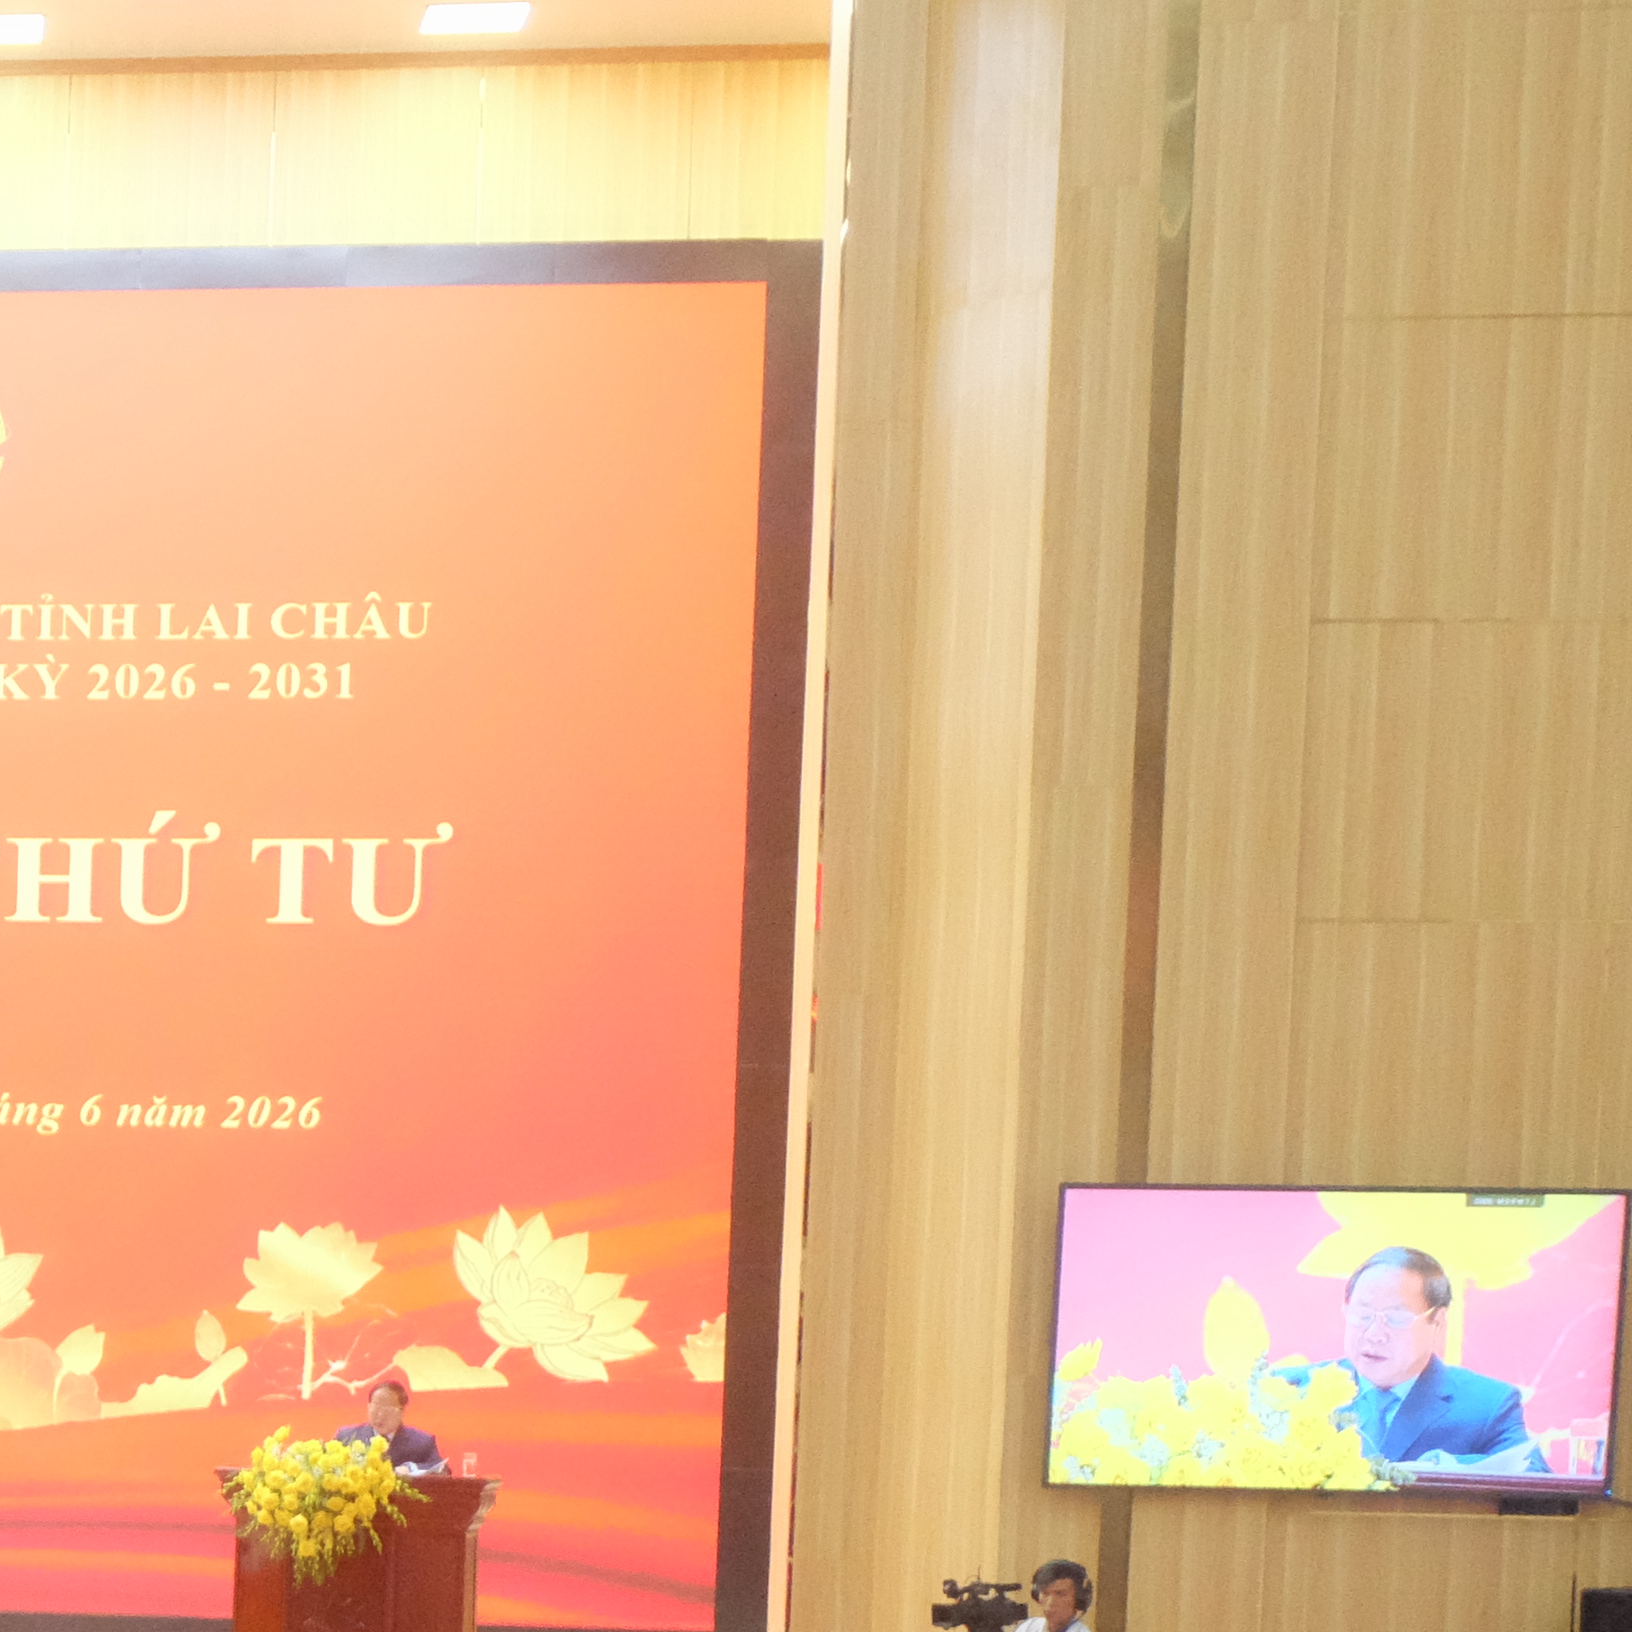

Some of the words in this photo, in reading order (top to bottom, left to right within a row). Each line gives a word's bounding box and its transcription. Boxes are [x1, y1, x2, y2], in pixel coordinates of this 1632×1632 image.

[0, 593, 138, 641] TỈNH
[156, 602, 252, 641] LAI
[271, 591, 432, 640] CHÂU
[87, 662, 196, 701] 2026
[213, 682, 230, 691] -
[248, 661, 353, 700] 2031
[251, 822, 453, 926] TƯ
[80, 1094, 103, 1127] 6
[116, 1094, 206, 1129] năm
[220, 1095, 323, 1131] 2026
